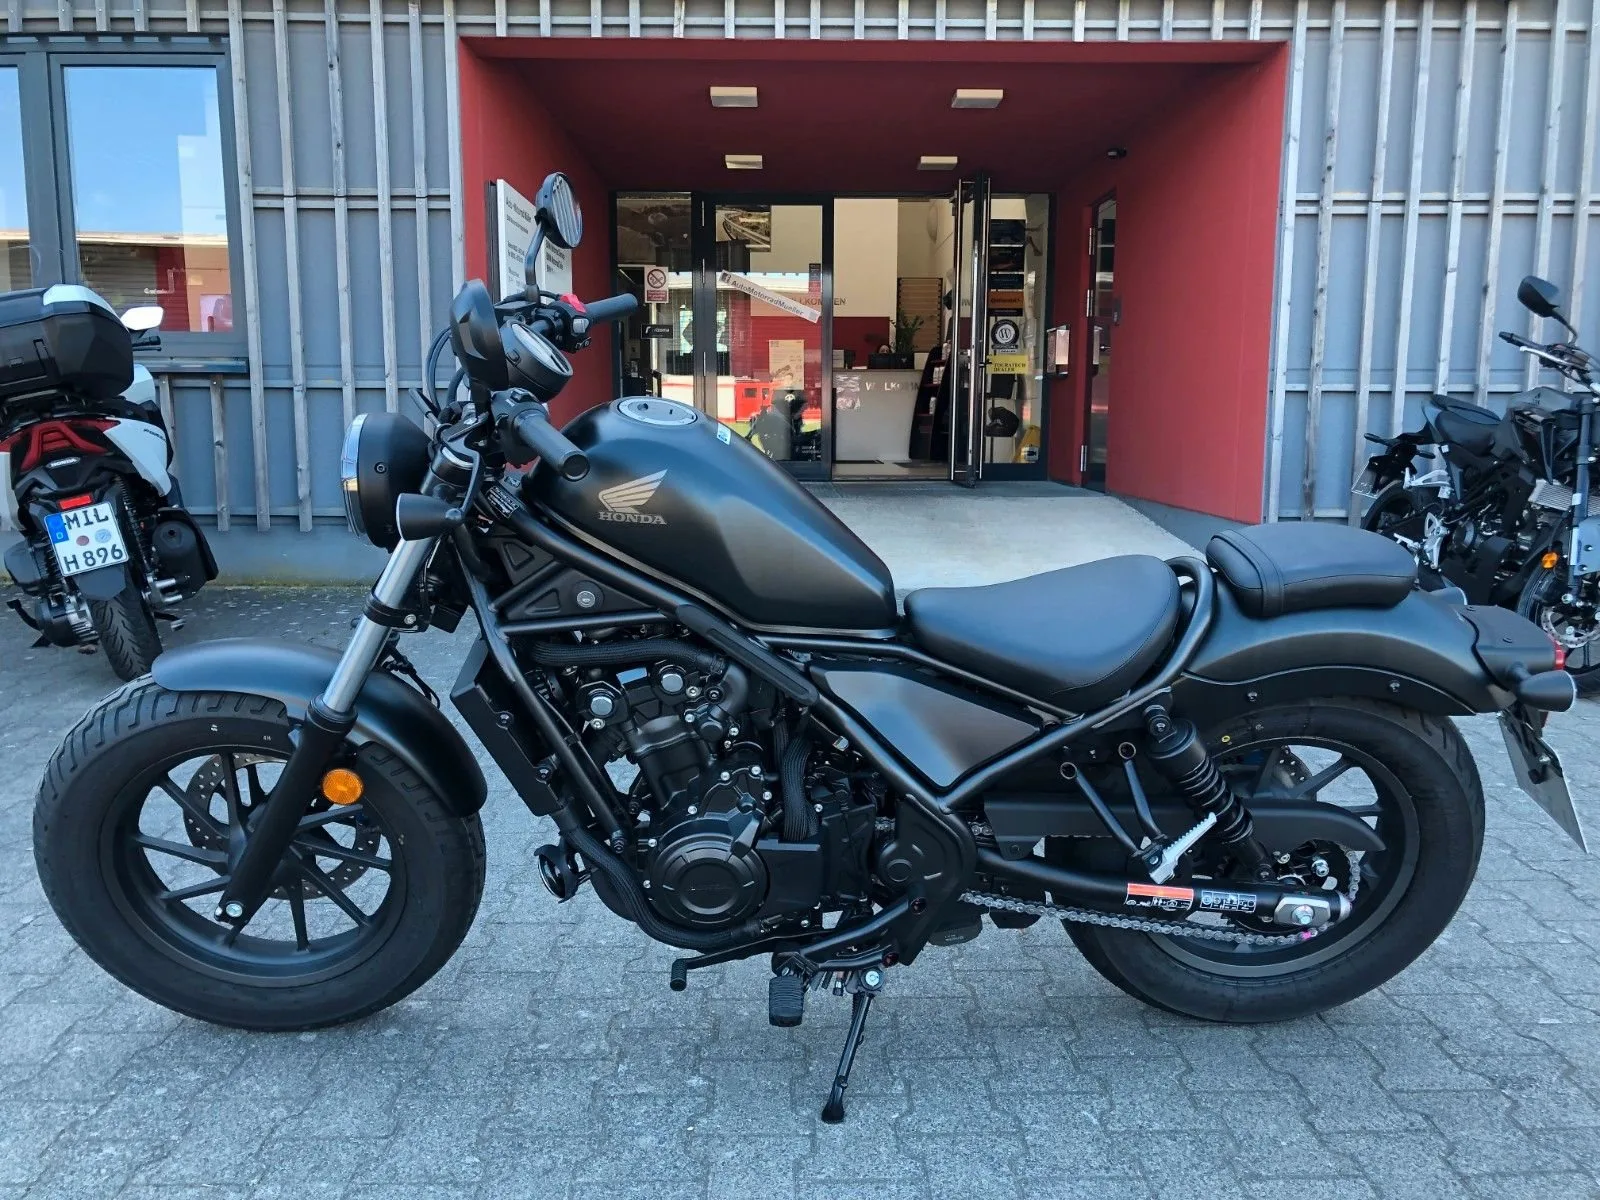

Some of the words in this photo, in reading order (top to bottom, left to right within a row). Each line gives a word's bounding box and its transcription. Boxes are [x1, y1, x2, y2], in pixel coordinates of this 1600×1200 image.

[64, 508, 109, 530] MIL
[598, 511, 667, 525] HONDA
[63, 554, 80, 572] H
[82, 544, 123, 567] 896
